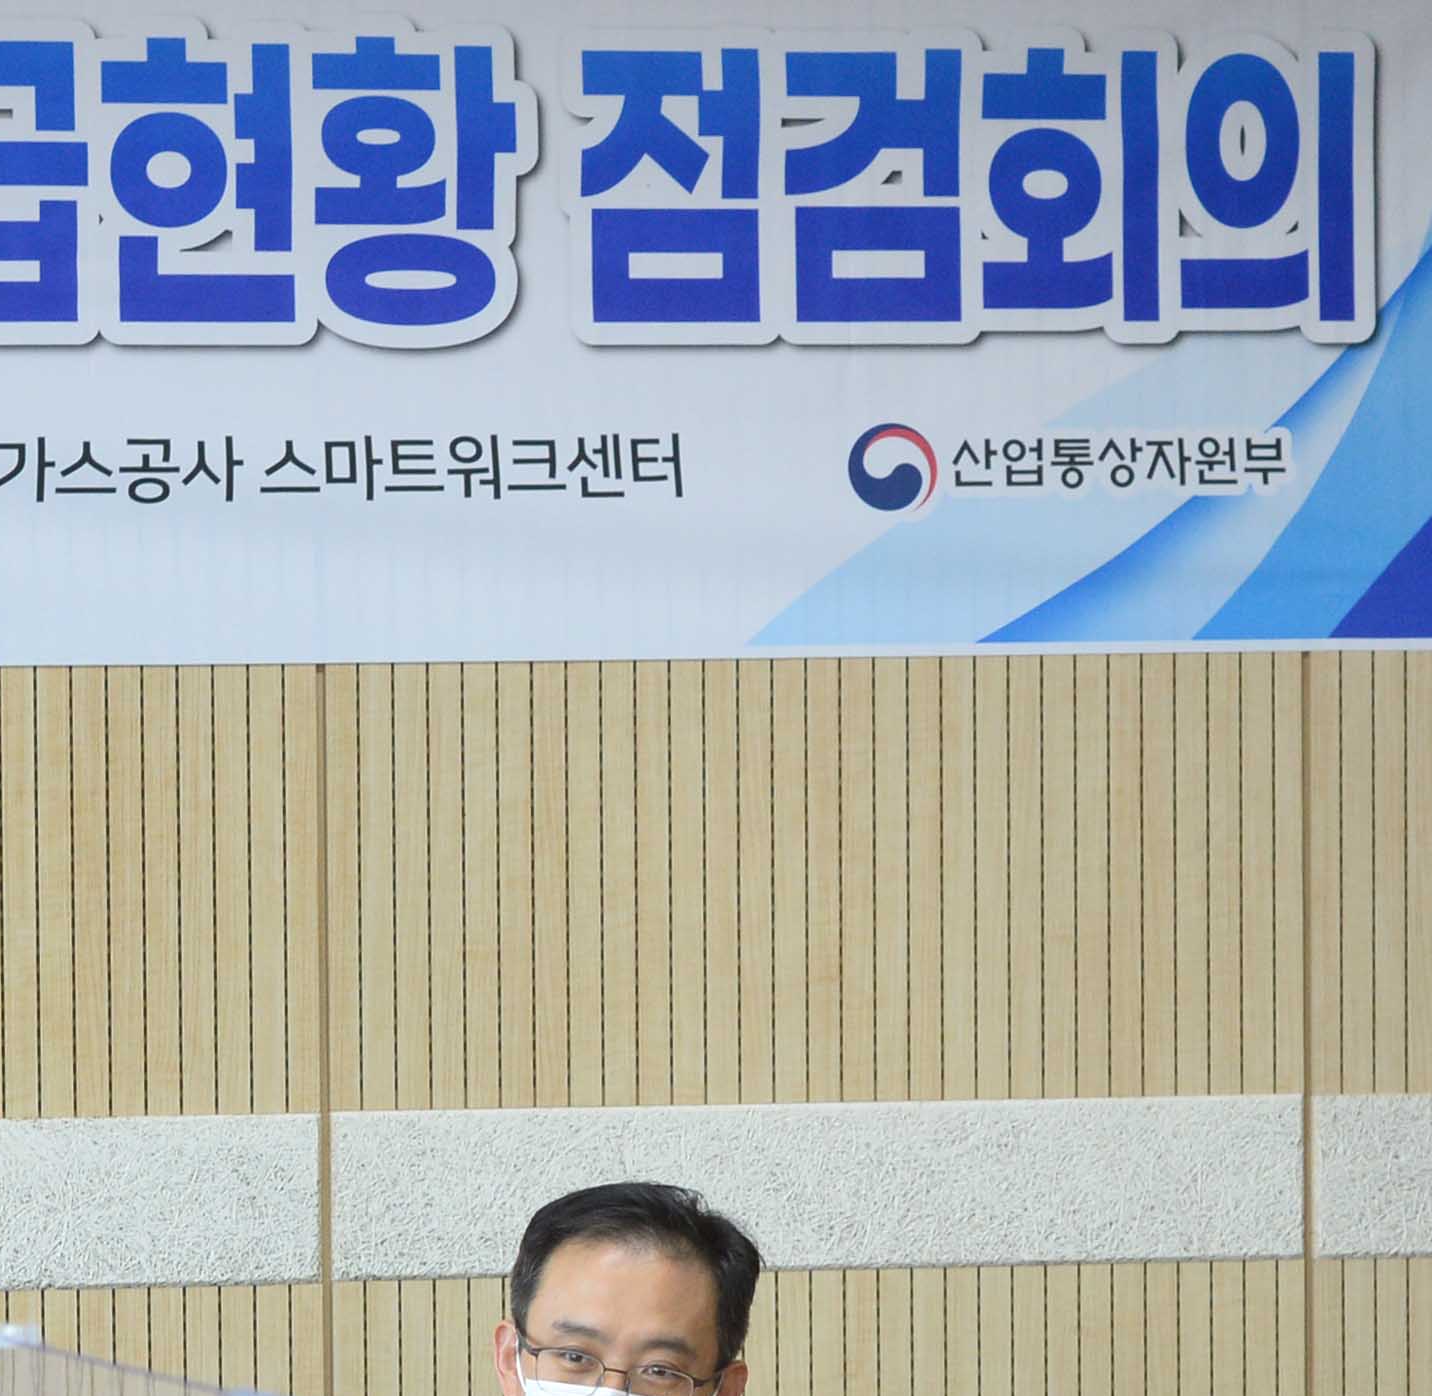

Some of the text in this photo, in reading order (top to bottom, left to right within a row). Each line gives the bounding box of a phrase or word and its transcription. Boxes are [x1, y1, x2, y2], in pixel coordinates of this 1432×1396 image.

[579, 48, 1354, 322] 점검회의
[260, 434, 684, 501] 스마트워크센터
[951, 435, 1286, 489] 산업통상자원부
